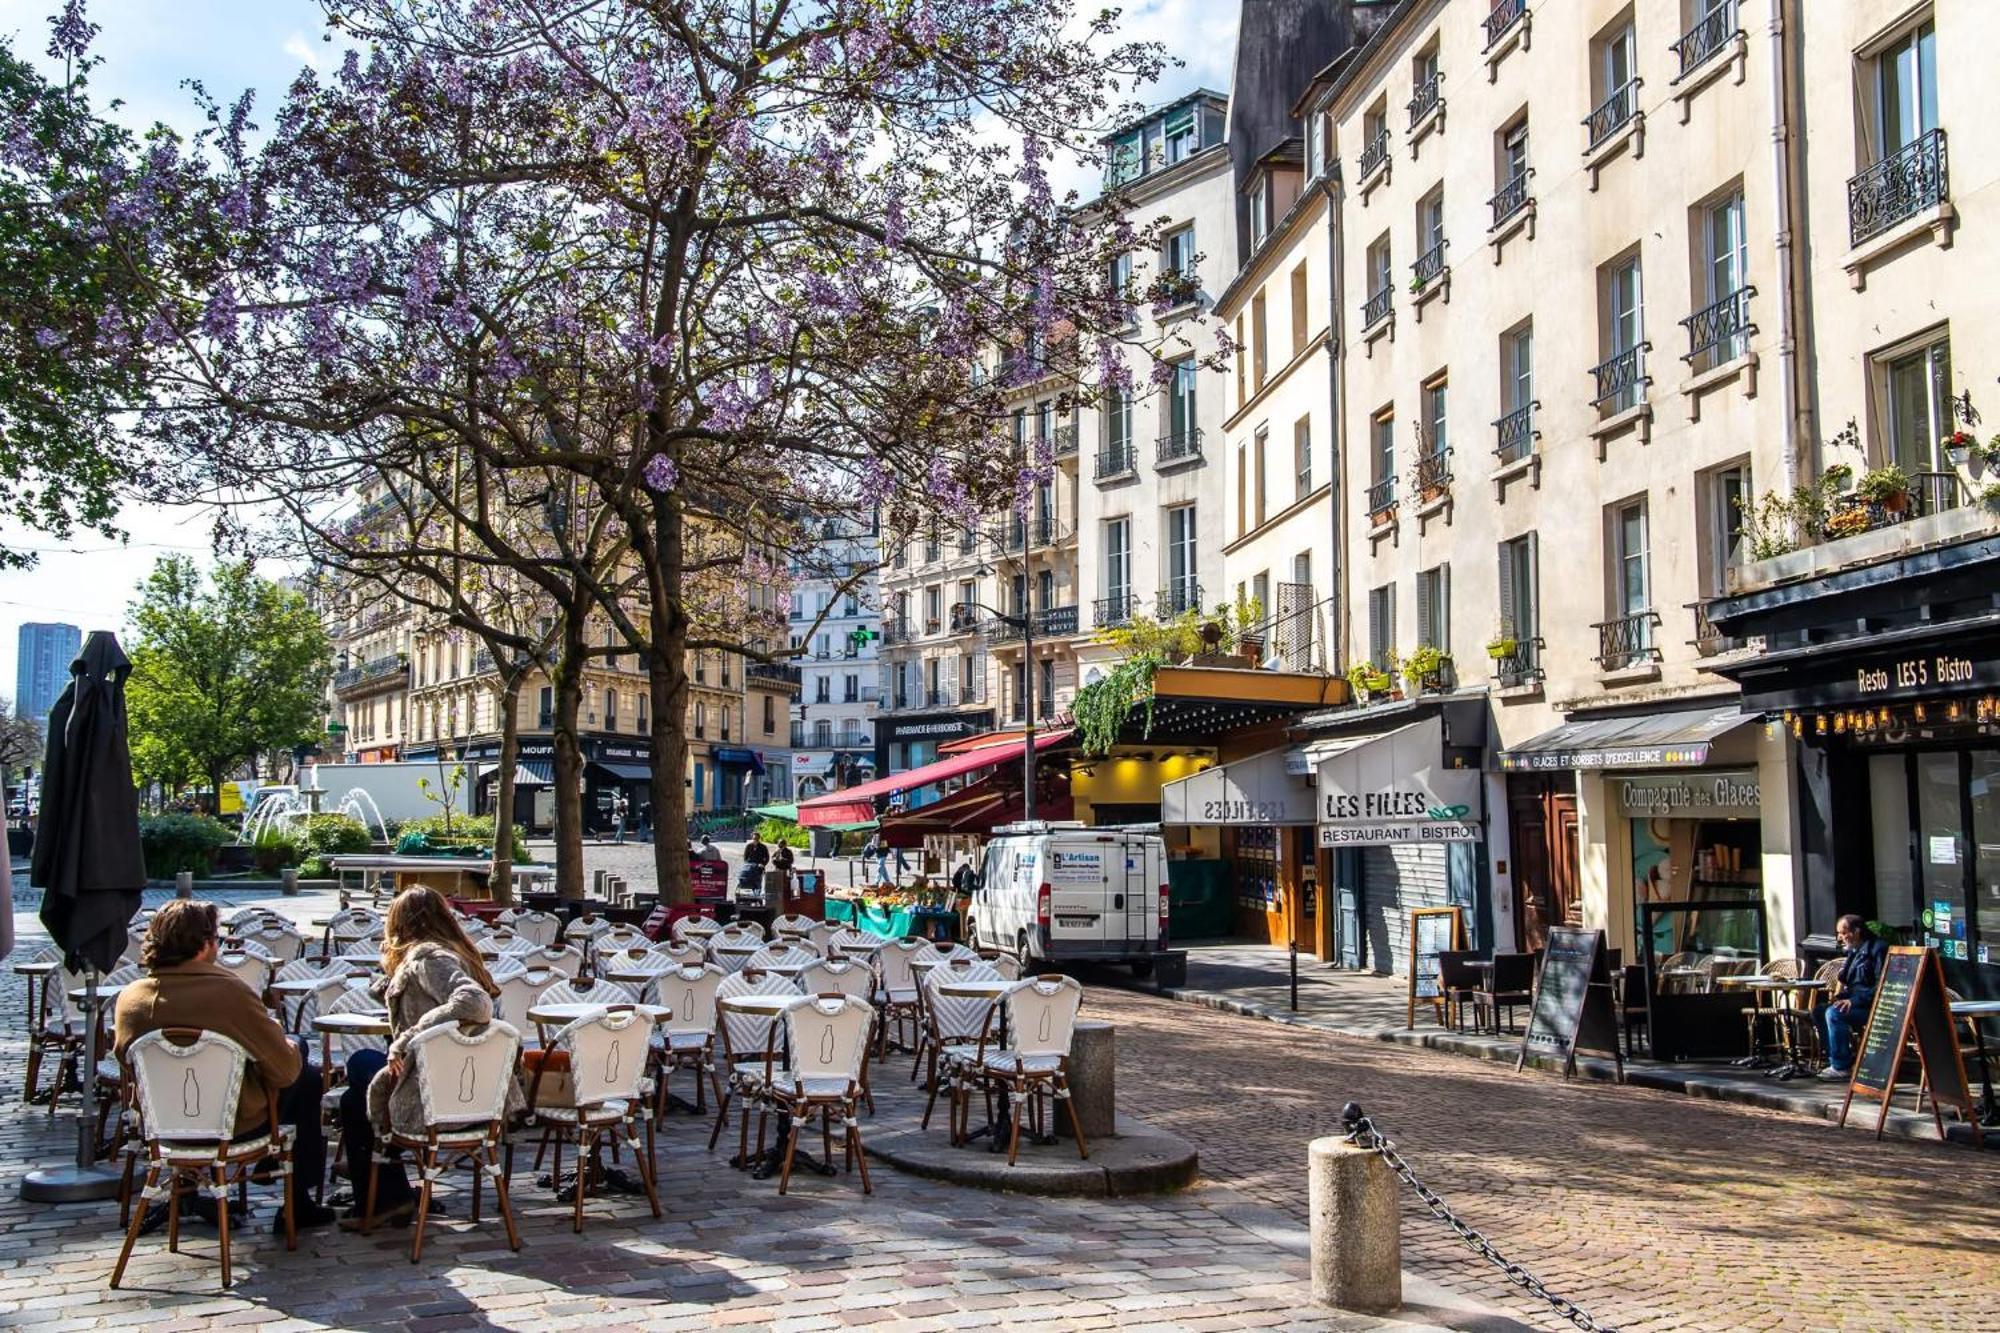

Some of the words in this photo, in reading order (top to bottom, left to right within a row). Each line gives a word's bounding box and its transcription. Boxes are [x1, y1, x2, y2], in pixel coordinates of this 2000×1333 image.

[1858, 669, 1888, 692] Resto
[1897, 662, 1917, 687] LES
[1919, 659, 1928, 685] 5
[1936, 656, 1973, 683] Bistro
[1533, 756, 1558, 767] GLACES
[1559, 755, 1570, 766] ET
[1571, 753, 1602, 765] SORBETS
[1605, 750, 1661, 764] D'EXCELLENCE
[1326, 794, 1360, 819] LES
[1365, 792, 1426, 818] FILLES
[1622, 780, 1690, 814] Compagnie
[1695, 790, 1711, 806] des
[1714, 778, 1760, 806] Glaces
[1323, 827, 1411, 843] RESTAURANT
[1421, 825, 1478, 840] BISTROT
[1062, 853, 1100, 862] L'Artisan
